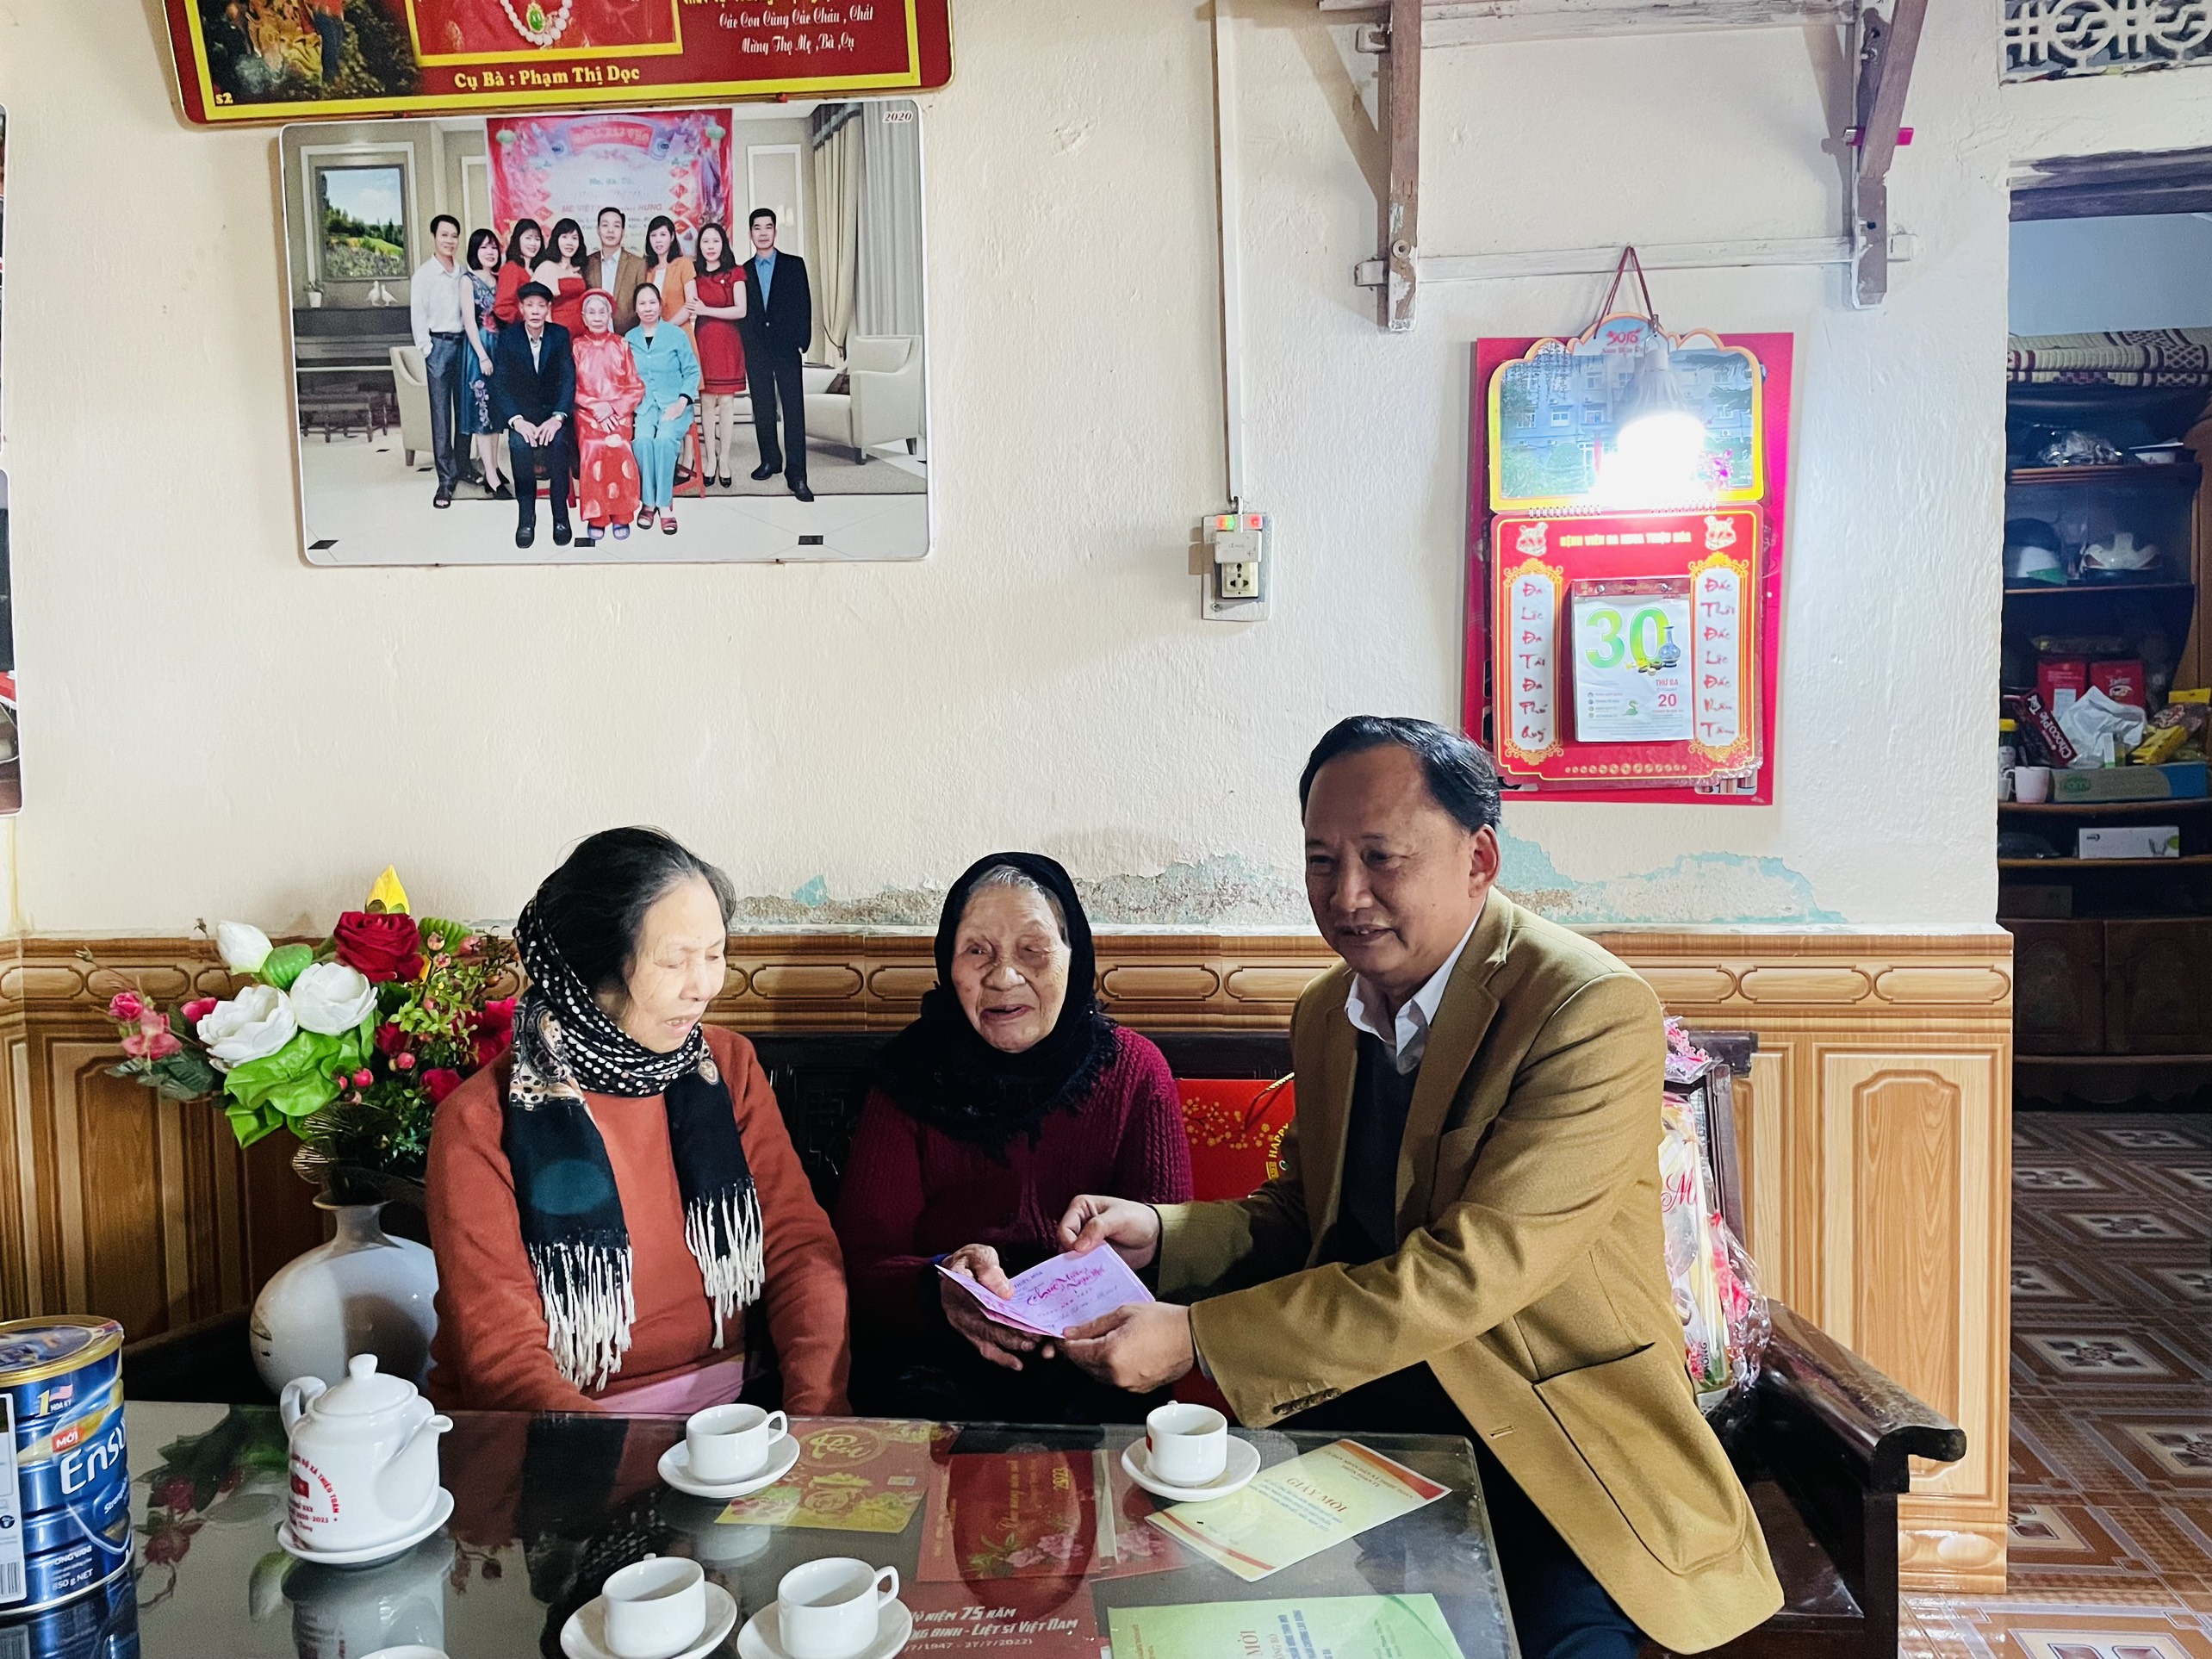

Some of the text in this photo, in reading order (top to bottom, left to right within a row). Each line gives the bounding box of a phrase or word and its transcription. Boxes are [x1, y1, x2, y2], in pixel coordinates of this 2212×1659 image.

[740, 11, 760, 28] Con
[454, 72, 478, 90] Cụ
[482, 70, 505, 87] Bà
[519, 68, 569, 87] Phạm
[572, 65, 603, 85] Thị
[606, 65, 640, 84] Dọc
[884, 111, 913, 122] 2020
[1586, 606, 1669, 669] 30
[1658, 693, 1677, 707] 20
[56, 1431, 78, 1449] MỚI
[1320, 1495, 1347, 1513] MỜI
[77, 1568, 94, 1582] NET
[925, 1609, 957, 1624] NIỆM
[960, 1606, 985, 1621] 75
[986, 1606, 1017, 1619] NĂM
[972, 1623, 1001, 1637] LIỆT
[1019, 1619, 1046, 1635] VIỆT
[1238, 1630, 1263, 1656] MỜI
